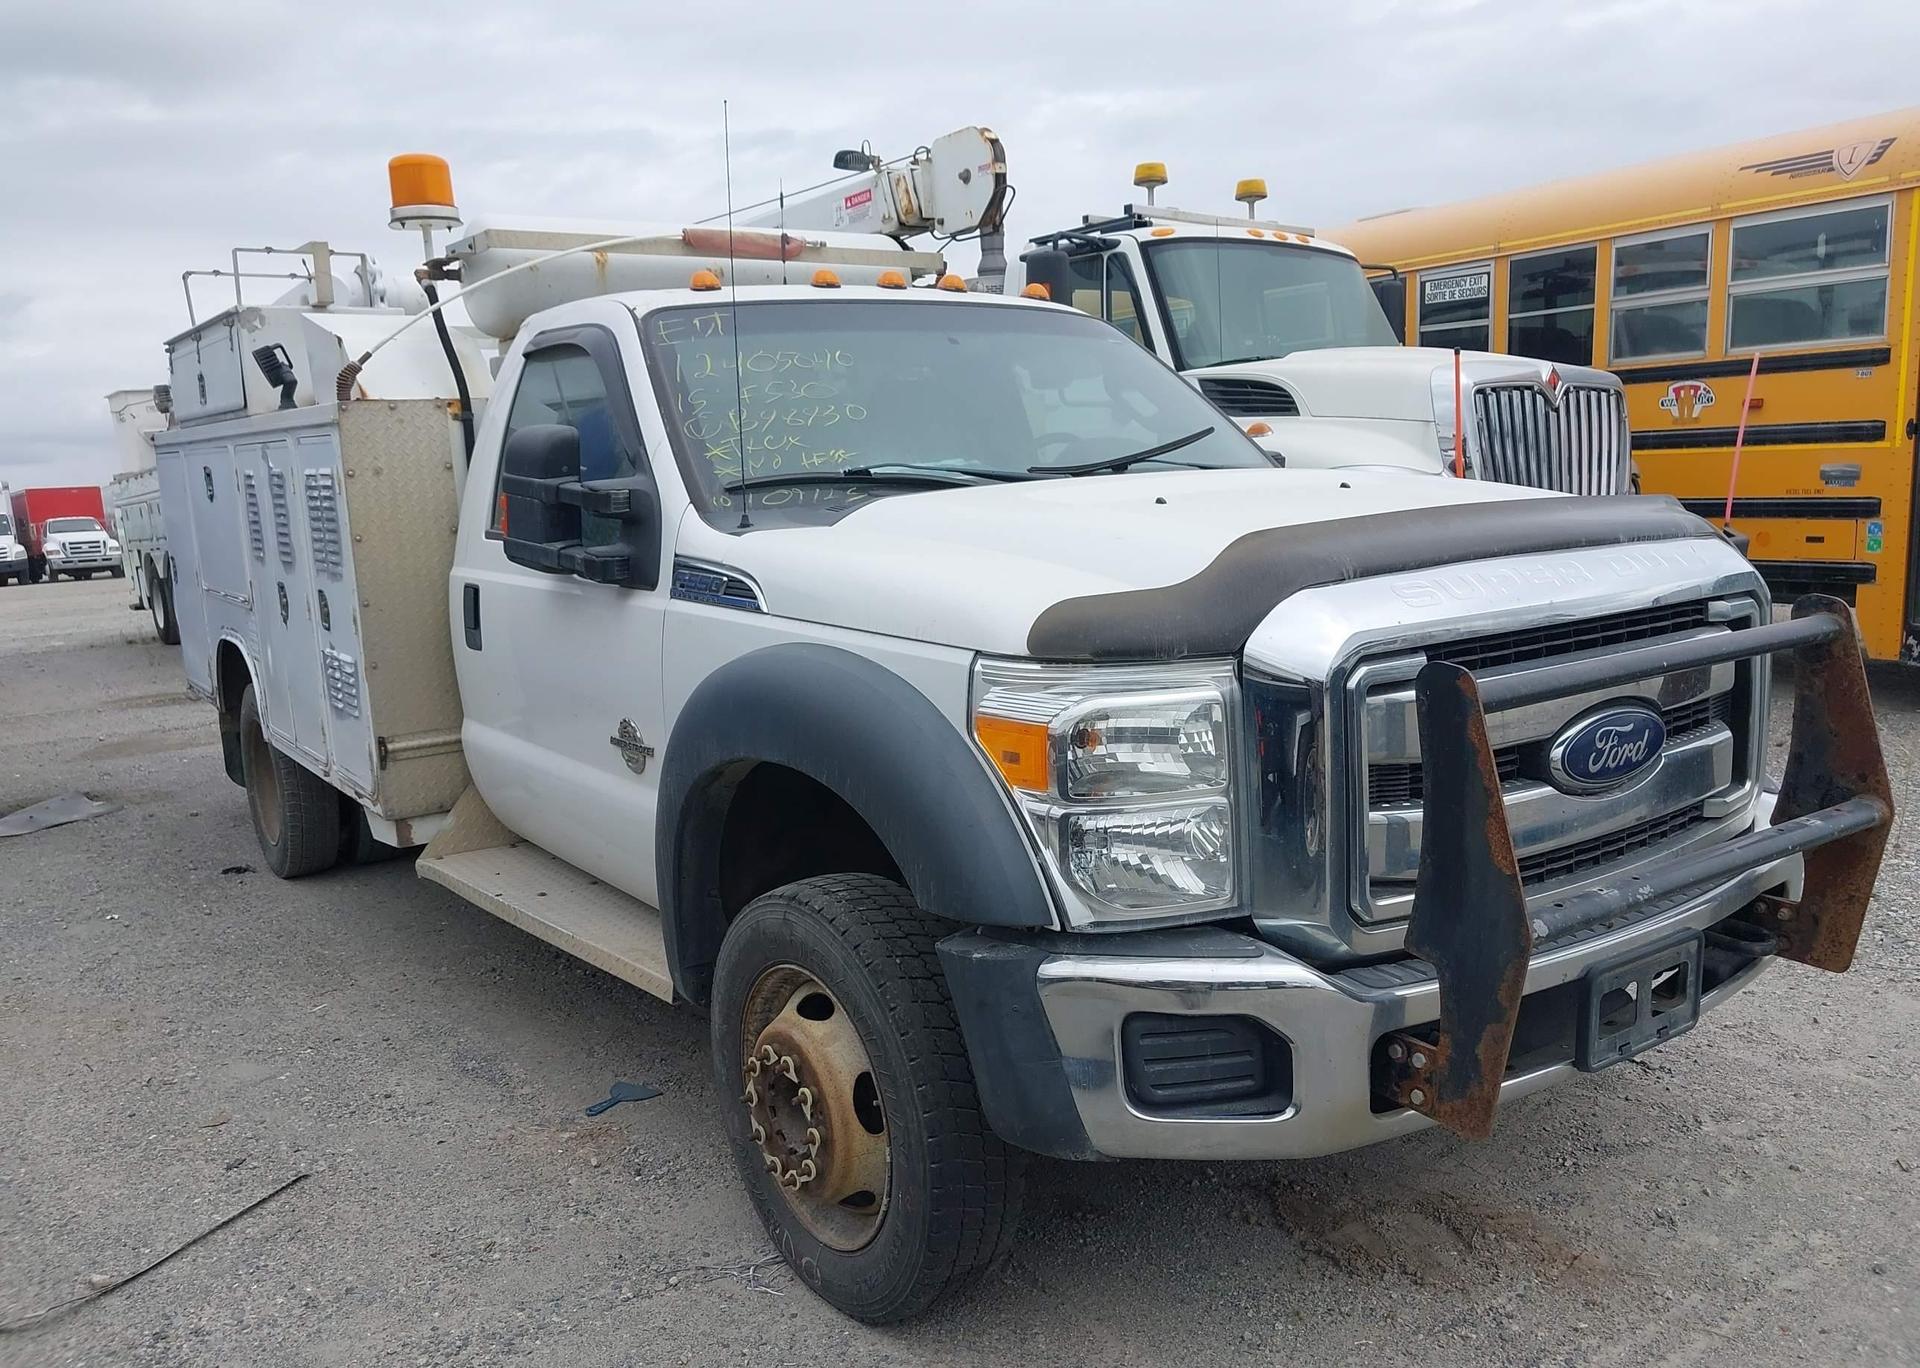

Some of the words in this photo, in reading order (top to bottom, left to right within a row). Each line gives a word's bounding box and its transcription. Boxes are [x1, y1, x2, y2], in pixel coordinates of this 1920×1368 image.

[1426, 290, 1447, 303] SORTIE
[1448, 288, 1457, 300] DE
[1458, 286, 1486, 297] SECOURS
[1429, 278, 1467, 291] EMERGENCY
[1469, 275, 1483, 286] EXIT
[1391, 558, 1594, 608] SUPER
[1602, 545, 1709, 578] DUTY
[1588, 722, 1650, 774] Ford
